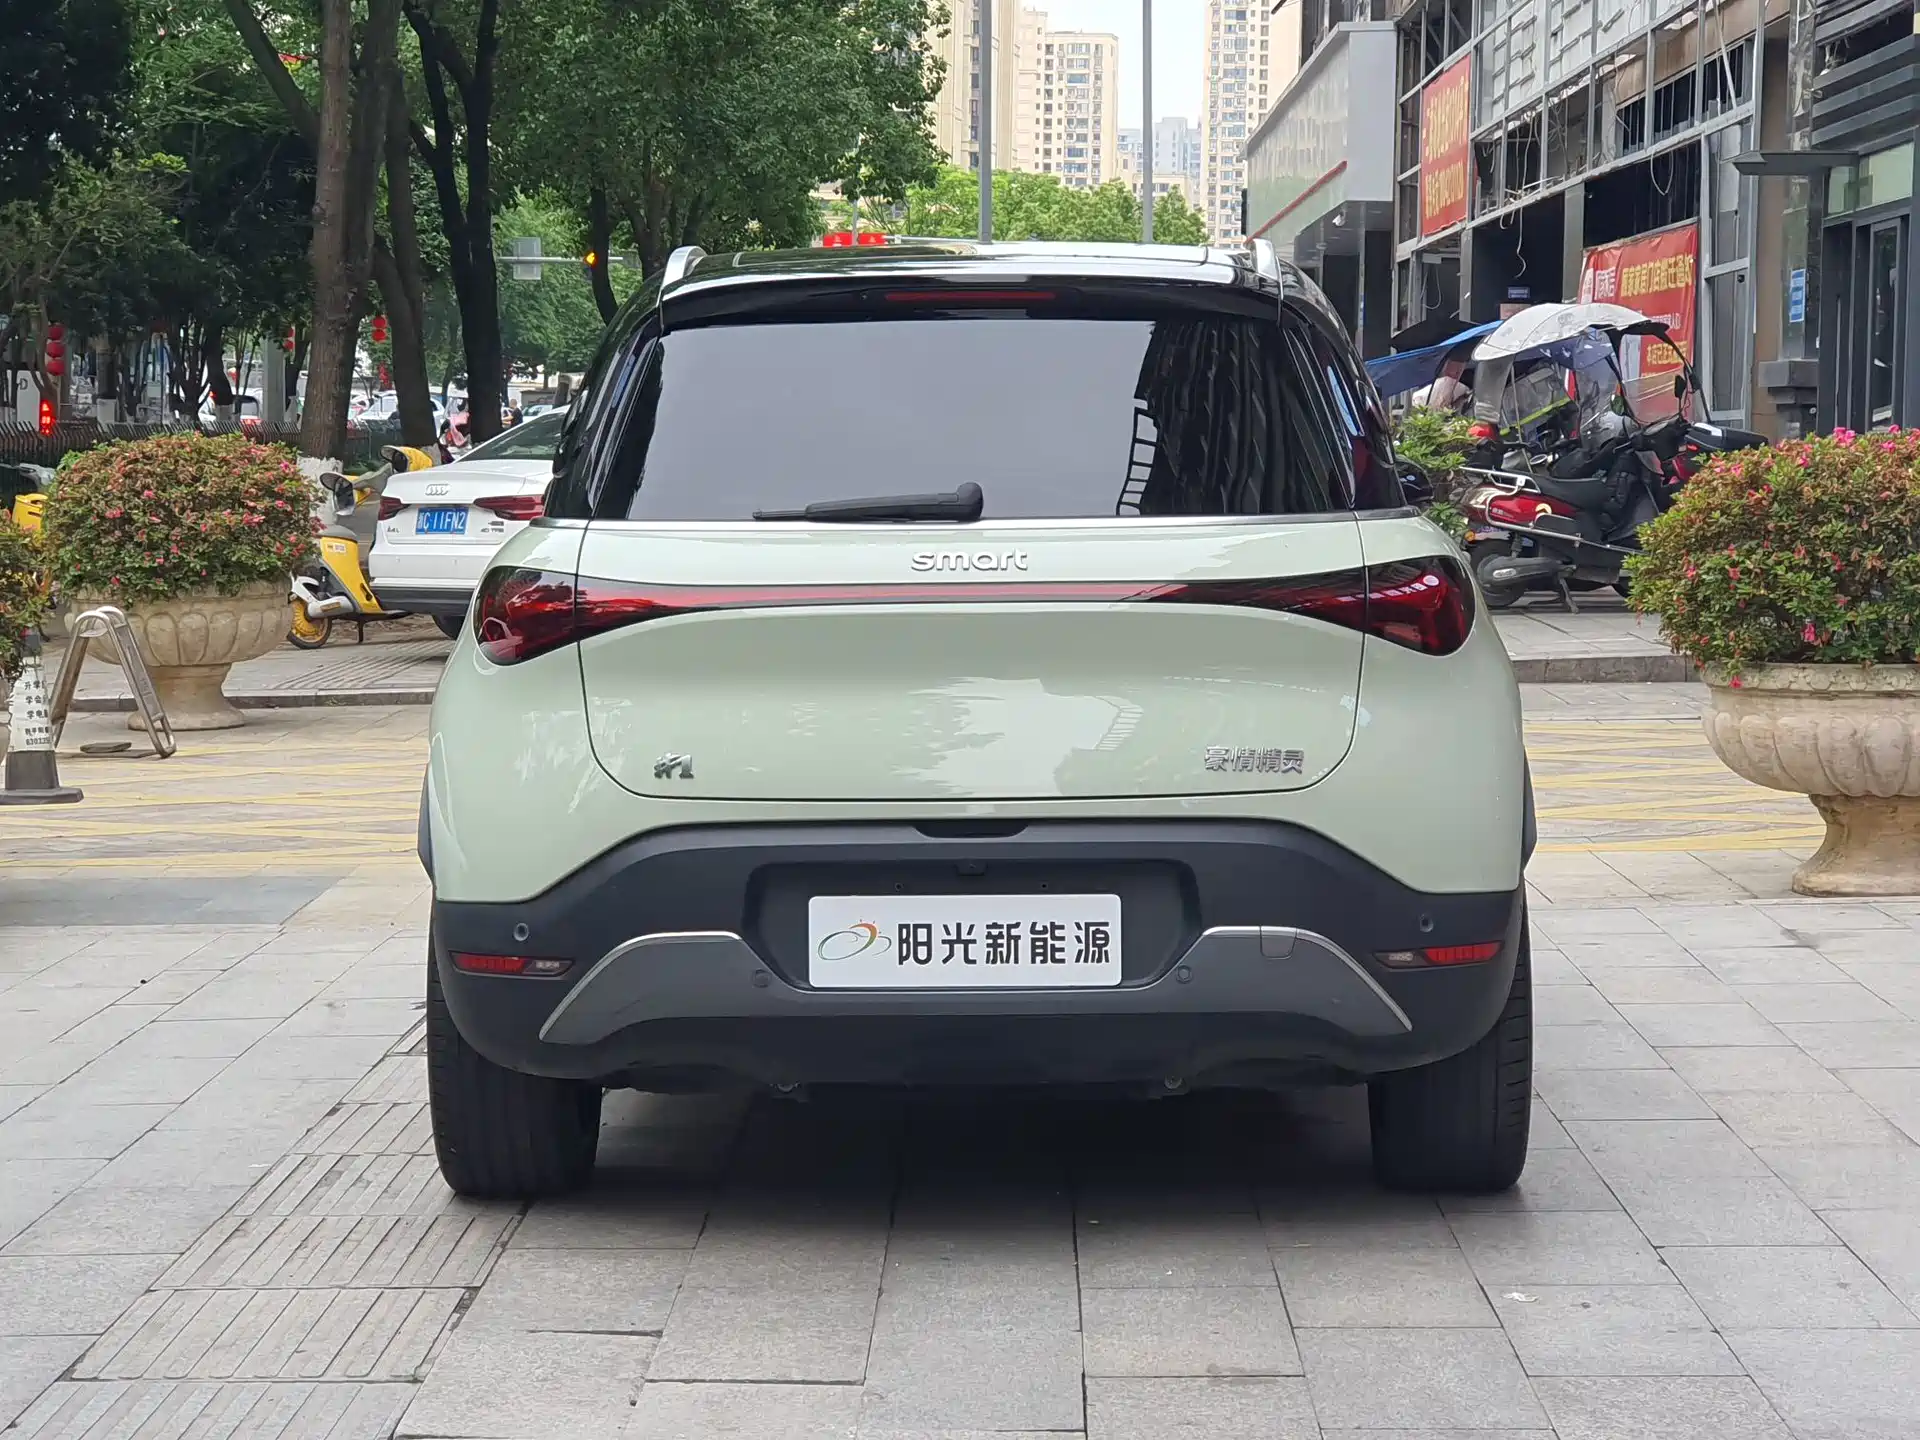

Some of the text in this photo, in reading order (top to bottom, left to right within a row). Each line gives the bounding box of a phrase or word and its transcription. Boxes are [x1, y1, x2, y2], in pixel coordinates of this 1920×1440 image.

[911, 548, 1028, 571] smart
[1204, 745, 1304, 774] 豪情精灵
[898, 922, 1110, 965] 阳光新能源
